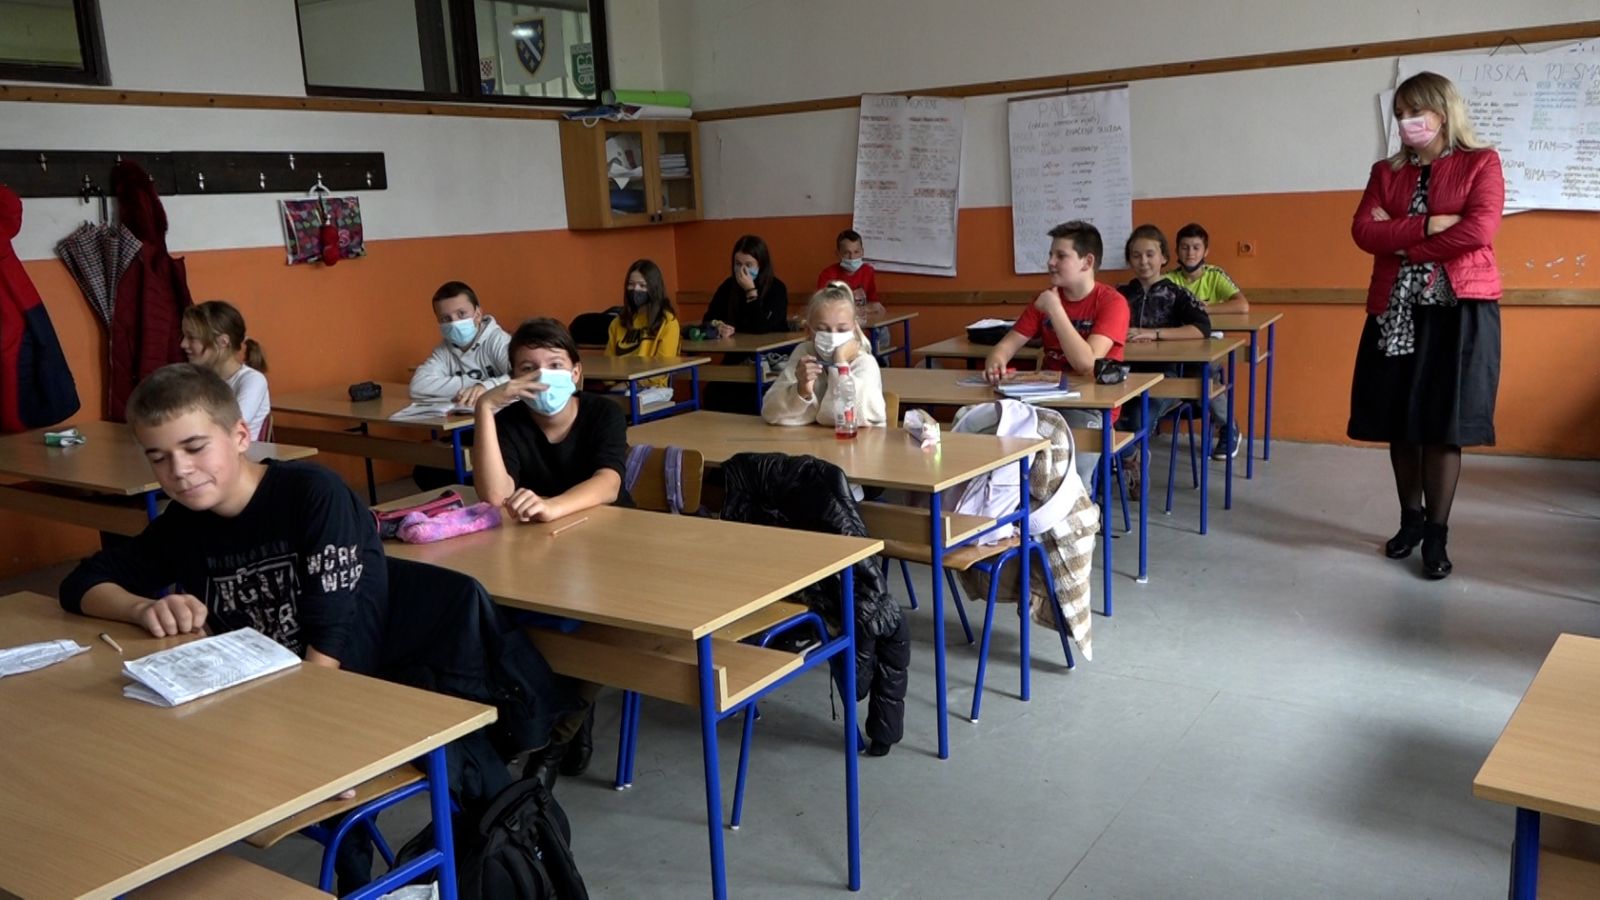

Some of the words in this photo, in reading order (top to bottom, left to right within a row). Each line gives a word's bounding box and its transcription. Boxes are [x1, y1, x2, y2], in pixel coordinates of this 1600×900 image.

[1458, 63, 1528, 82] LIRSKA
[1528, 140, 1557, 151] RITAM
[1524, 168, 1546, 181] RIMA
[306, 544, 357, 575] WORK
[321, 564, 363, 592] WEAR
